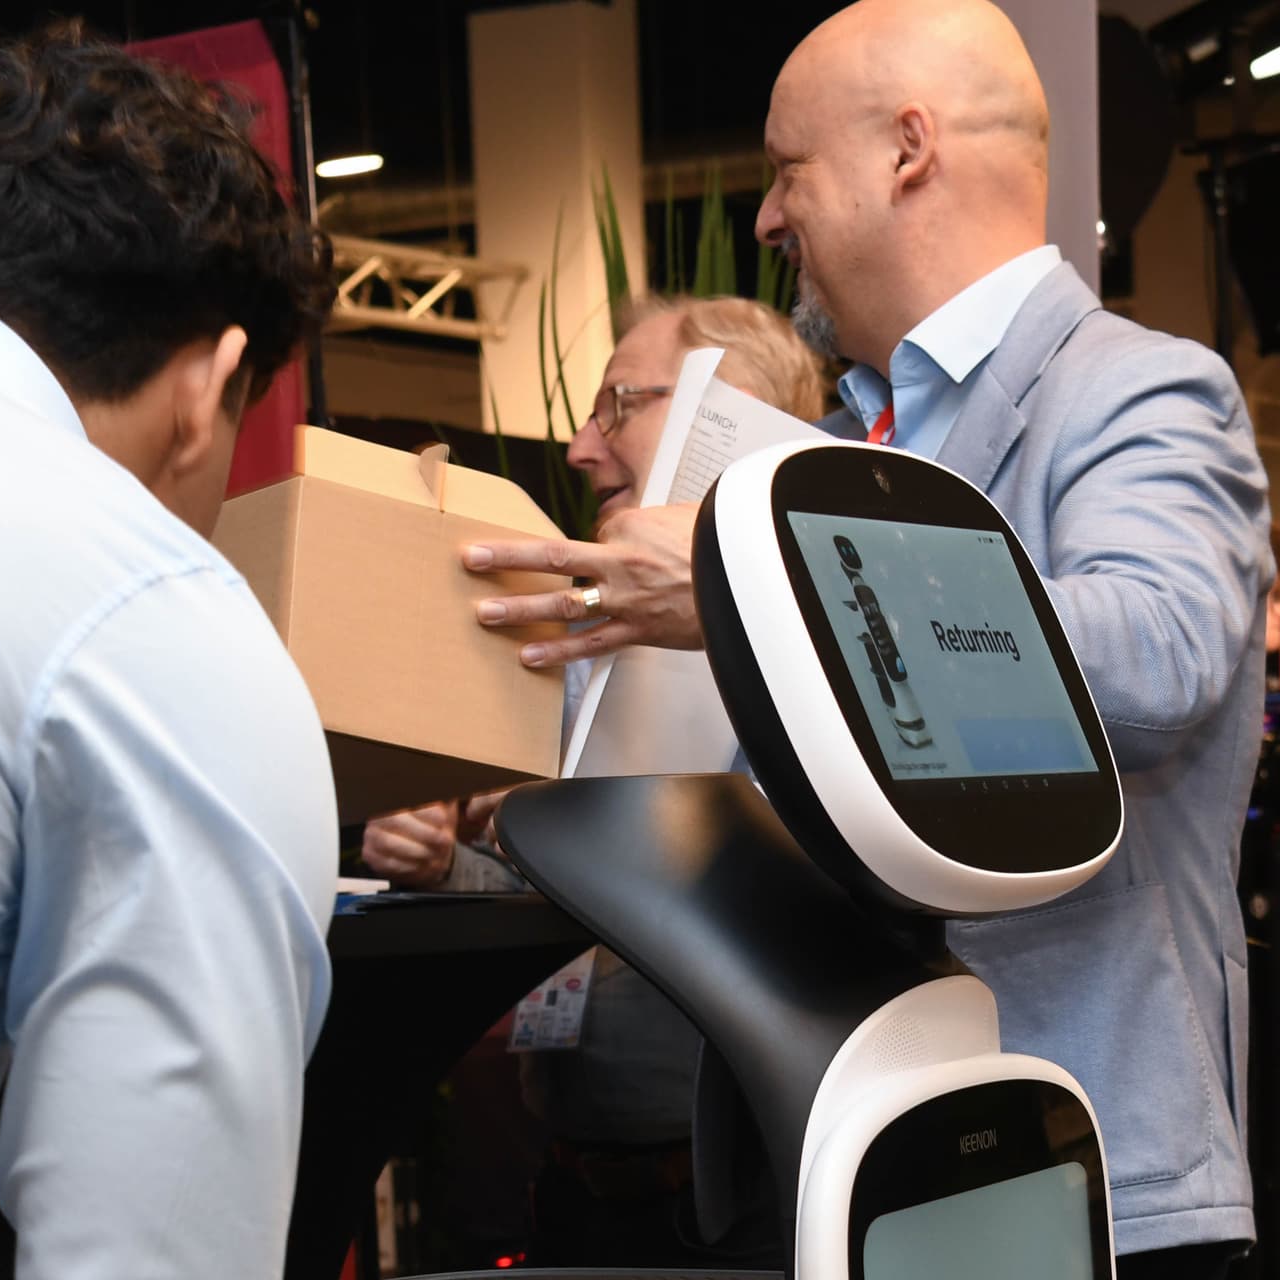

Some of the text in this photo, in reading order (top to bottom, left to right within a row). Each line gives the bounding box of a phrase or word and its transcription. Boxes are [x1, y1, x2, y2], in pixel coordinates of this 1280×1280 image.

[701, 407, 738, 433] LUNCH
[930, 620, 1021, 662] Returning
[960, 1128, 997, 1154] KEENON
